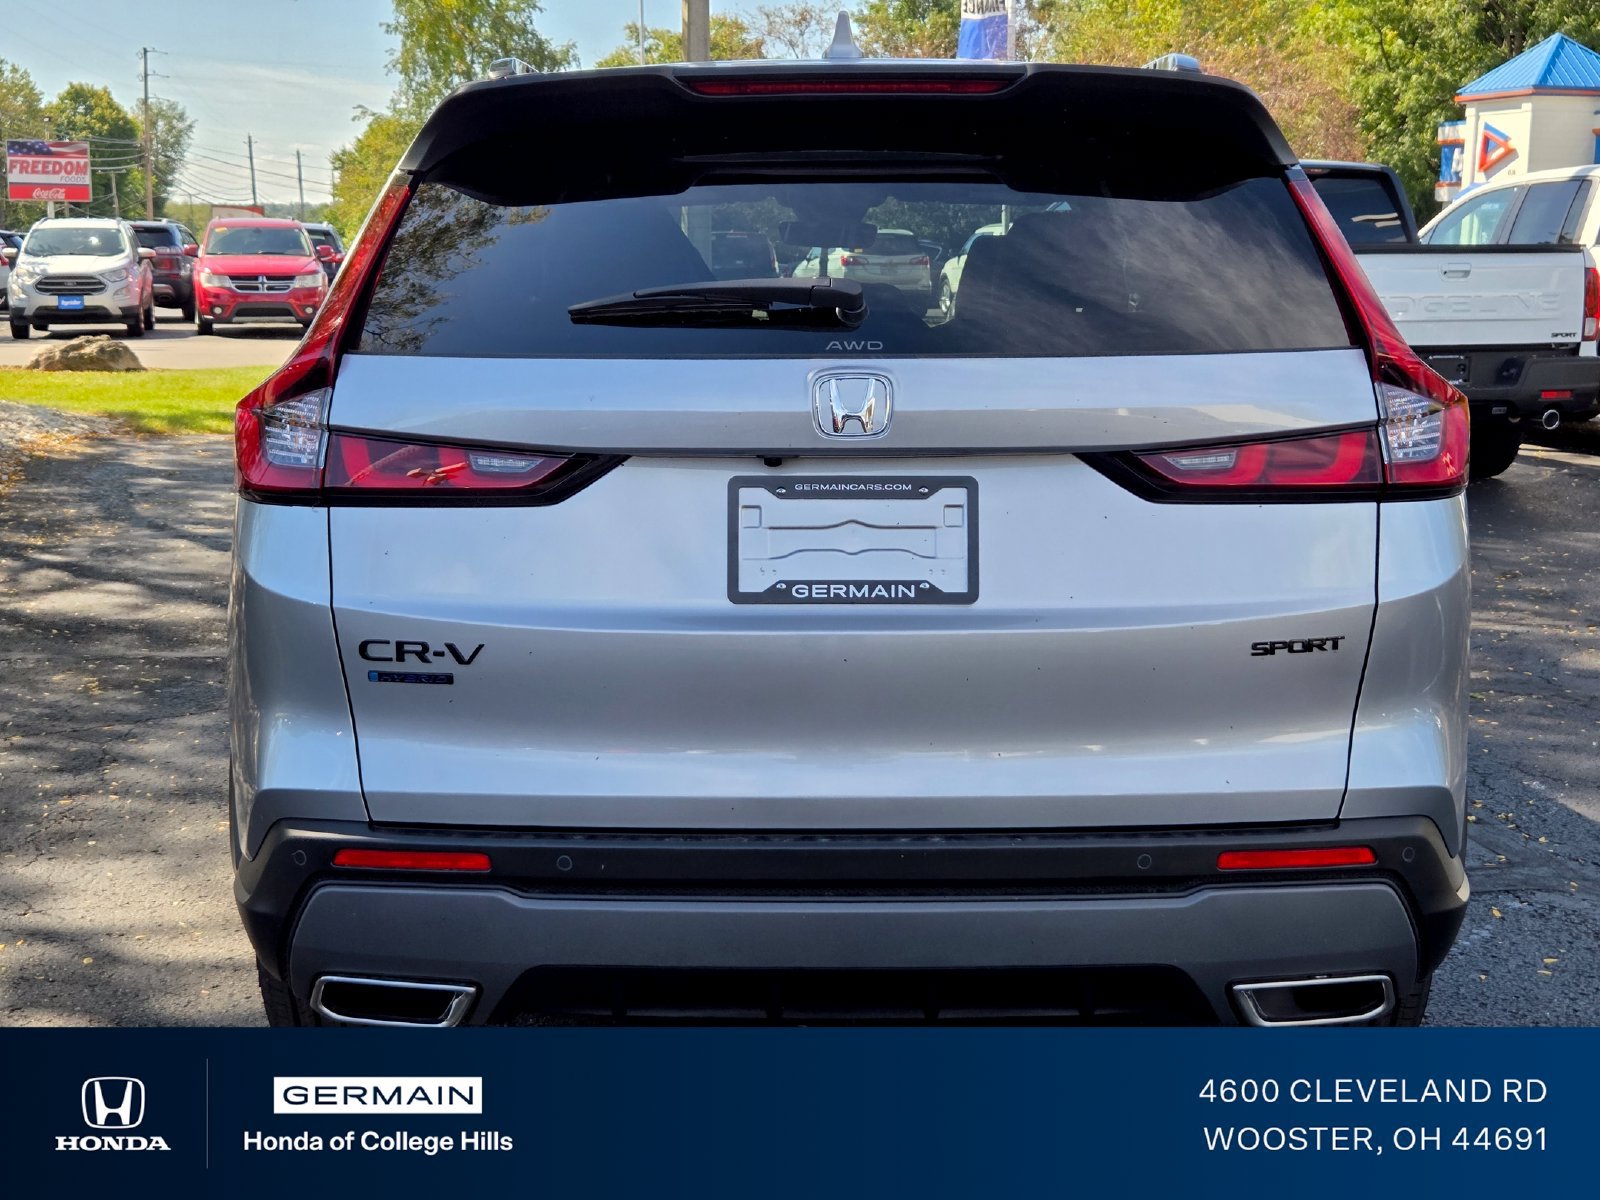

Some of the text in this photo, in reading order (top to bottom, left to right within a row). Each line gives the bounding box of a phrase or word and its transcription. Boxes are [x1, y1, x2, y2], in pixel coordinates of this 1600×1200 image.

[8, 159, 89, 176] FREEDOM
[60, 175, 87, 184] FOODS
[825, 340, 884, 351] AWD
[794, 483, 912, 491] GERMAINCARS.COM
[791, 584, 915, 599] GERMAIN
[358, 639, 486, 665] CR-V
[1250, 635, 1346, 656] SPORT
